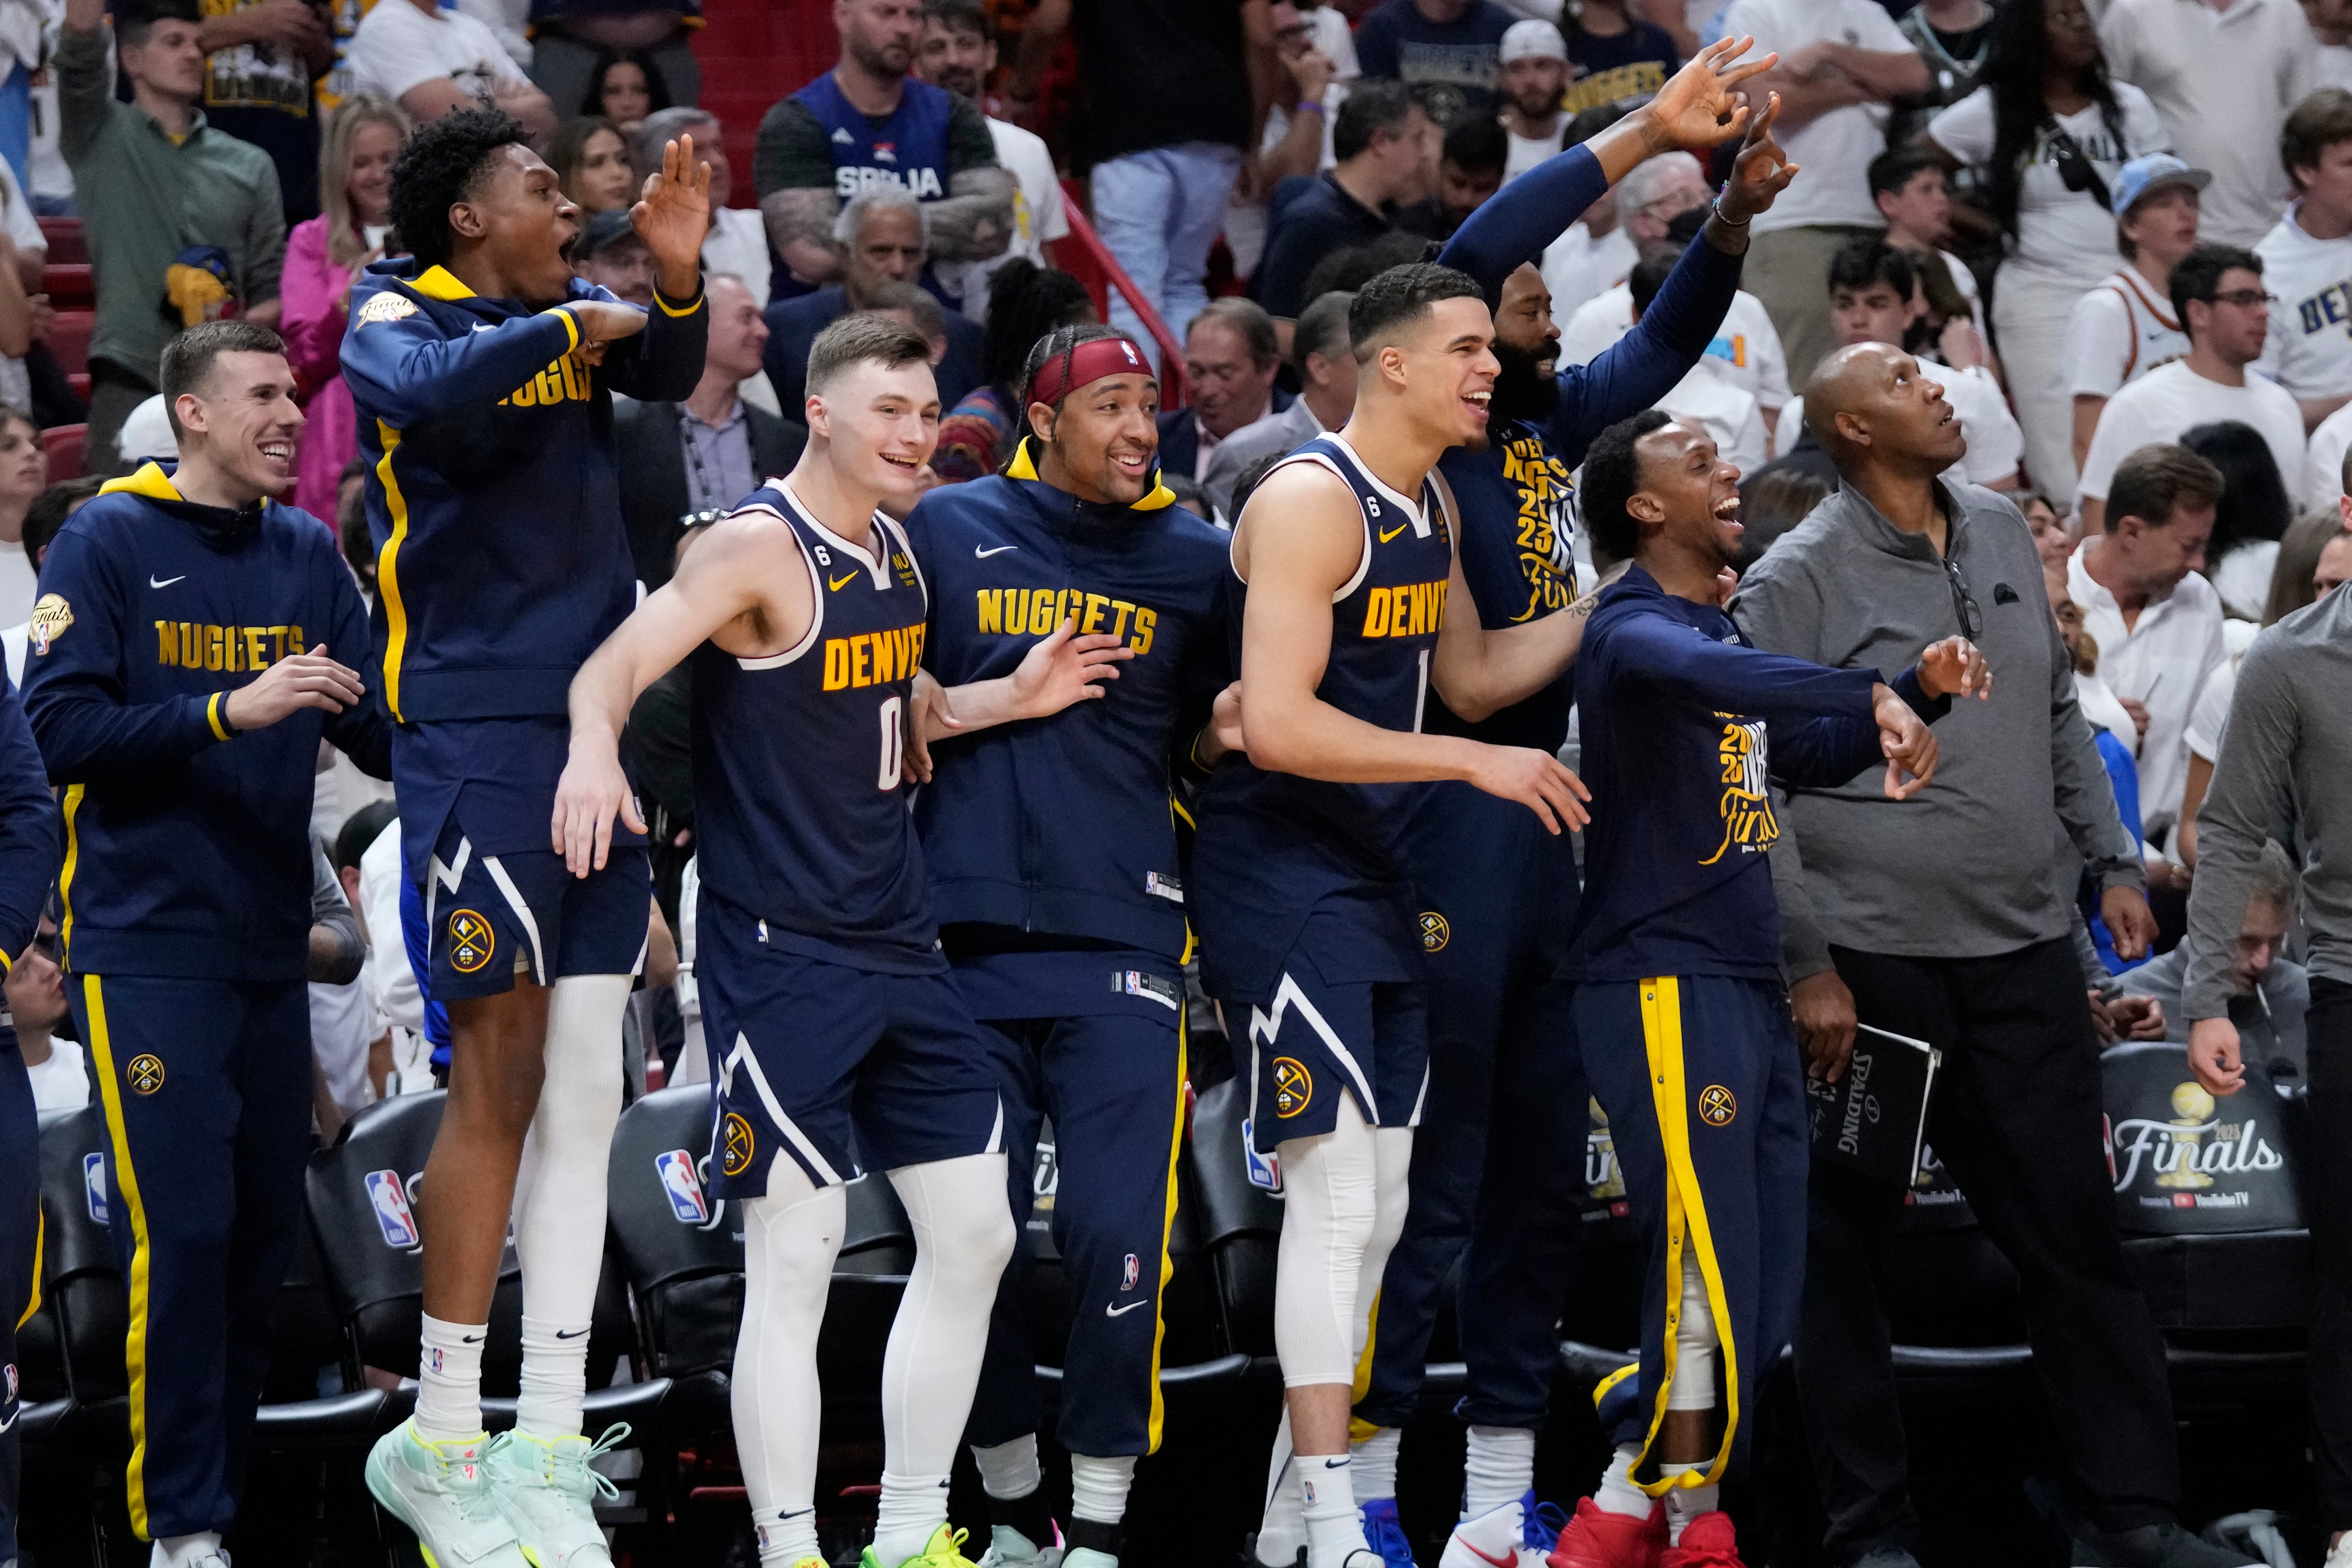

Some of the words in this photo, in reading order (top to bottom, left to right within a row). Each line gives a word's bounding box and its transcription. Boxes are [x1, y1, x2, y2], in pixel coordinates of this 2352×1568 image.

[1366, 496, 1381, 518] 6
[814, 545, 831, 566] 6
[1516, 516, 1553, 554] 23
[977, 588, 1158, 655] NUGGETS
[155, 620, 305, 673] NUGGETS
[1413, 649, 1430, 733] 1
[878, 696, 903, 791] 0
[1719, 723, 1751, 753] 20
[1838, 1050, 1872, 1155] SPALDING
[2214, 1123, 2241, 1141] 2023
[2114, 1118, 2283, 1192] Finals
[389, 1228, 407, 1241] NBA
